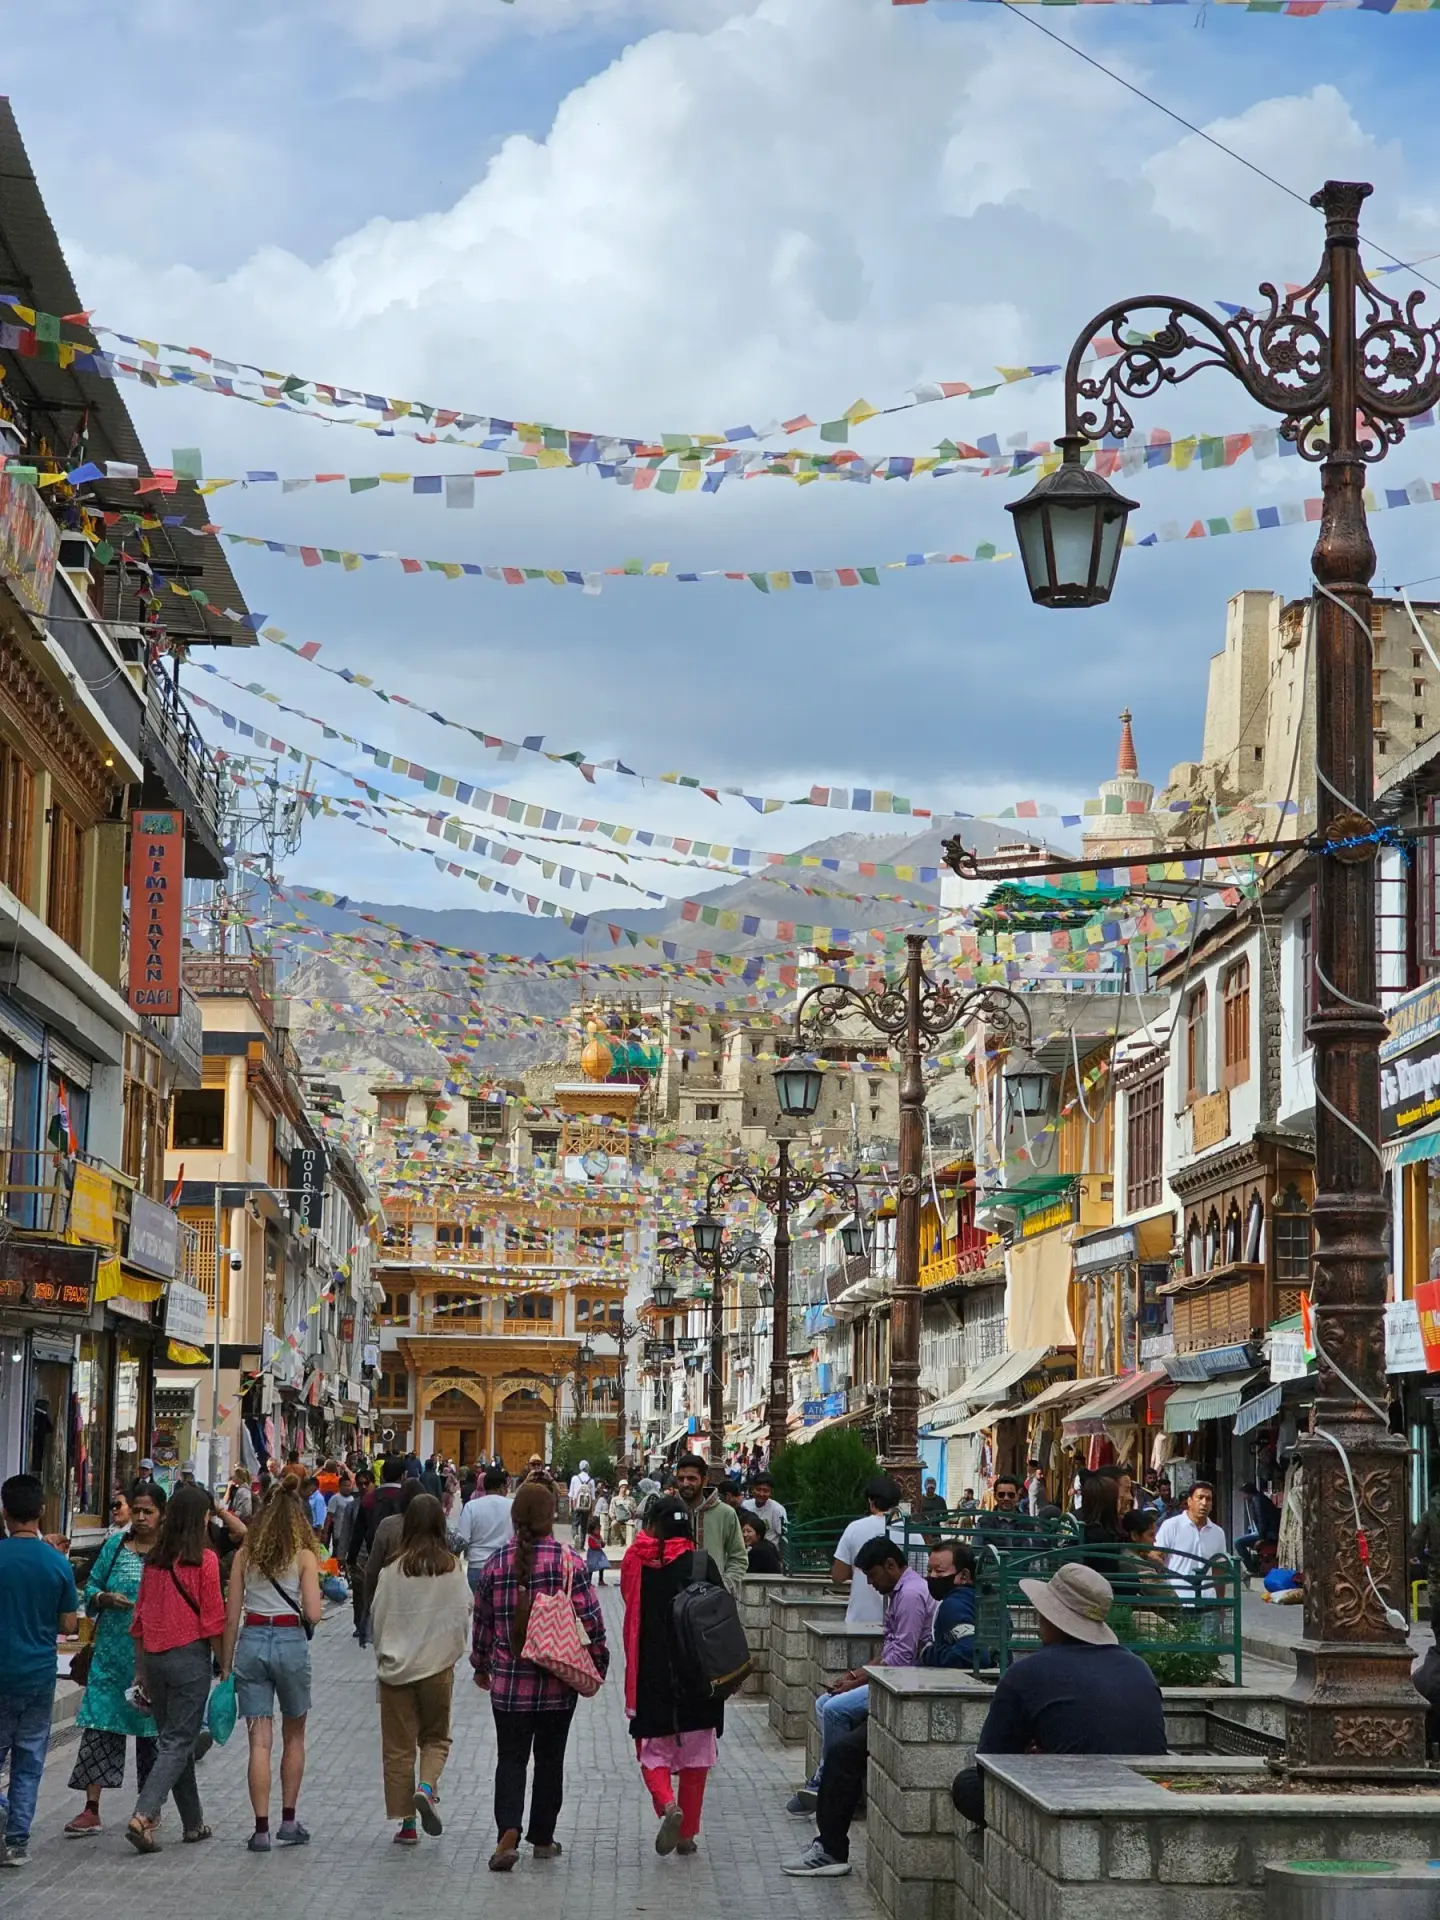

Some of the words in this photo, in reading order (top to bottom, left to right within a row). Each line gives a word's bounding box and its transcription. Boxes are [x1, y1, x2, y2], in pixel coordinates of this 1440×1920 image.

[145, 844, 168, 982] HIMALAYAN
[135, 989, 172, 1005] CAFE
[301, 1149, 316, 1225] monsoon
[32, 1282, 54, 1300] ISD
[62, 1286, 89, 1303] FAX
